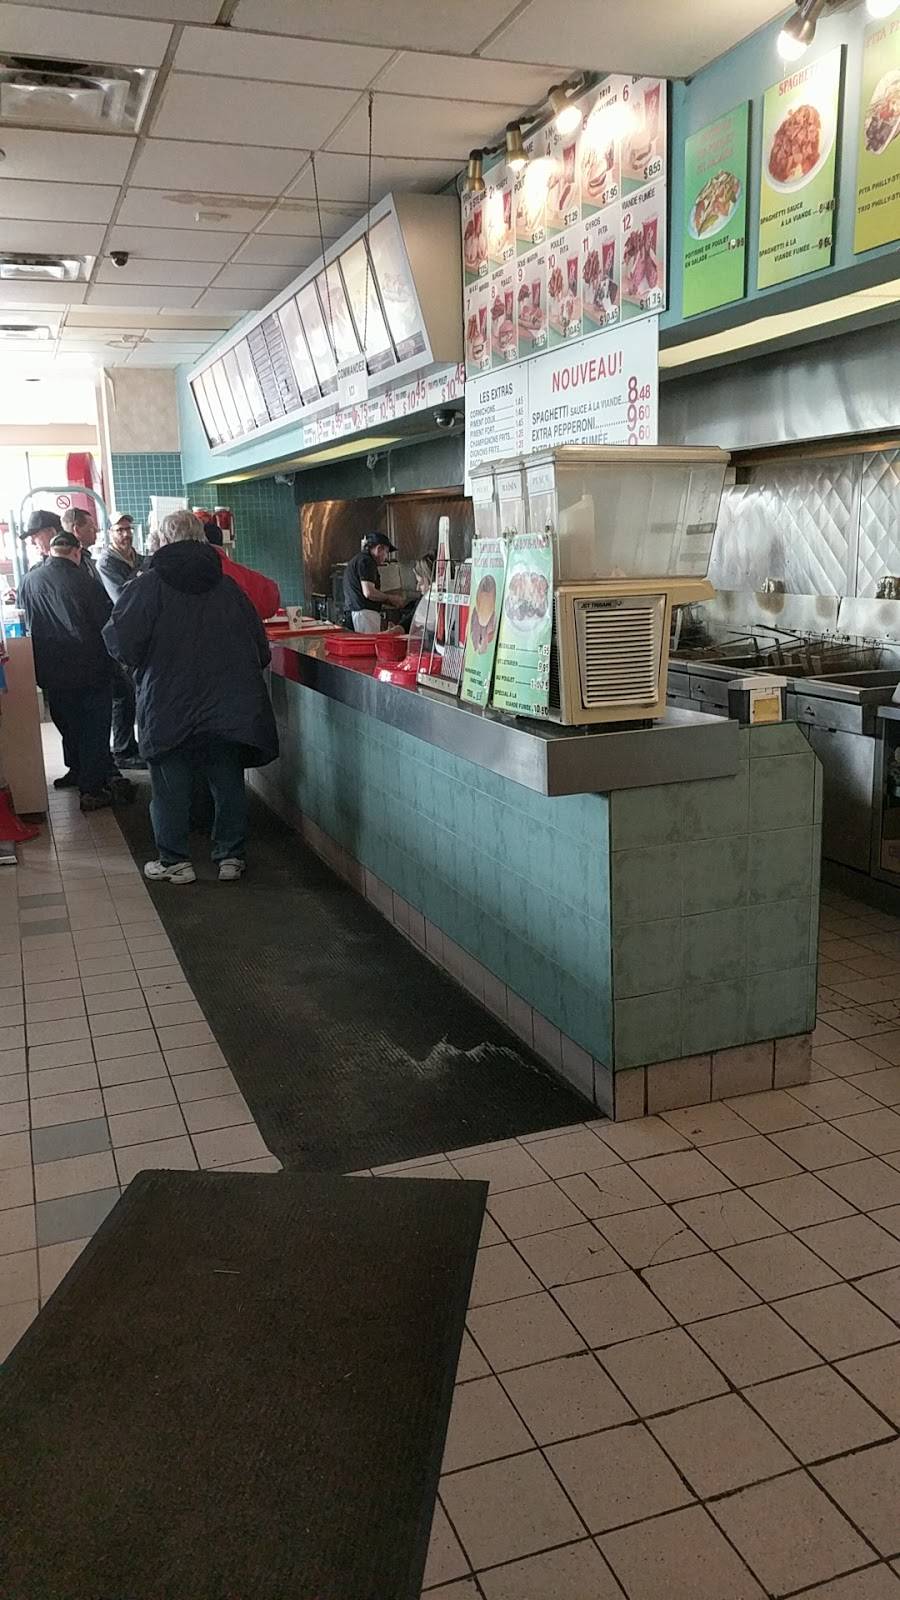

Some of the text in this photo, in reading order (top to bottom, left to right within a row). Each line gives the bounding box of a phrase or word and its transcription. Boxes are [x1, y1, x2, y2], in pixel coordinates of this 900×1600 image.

[622, 213, 631, 232] 12
[583, 236, 589, 253] 11
[548, 254, 556, 270] 10
[337, 360, 365, 380] COMMANDEZ
[552, 351, 622, 393] NOUVEAU!
[479, 382, 513, 404] LES EXTRAS
[532, 405, 569, 425] SPAGHETTI
[570, 404, 588, 417] SAUCE
[593, 402, 600, 411] LA
[601, 394, 622, 409] VIANDE
[532, 426, 552, 442] EXTRA
[553, 416, 595, 438] PEPPERONI
